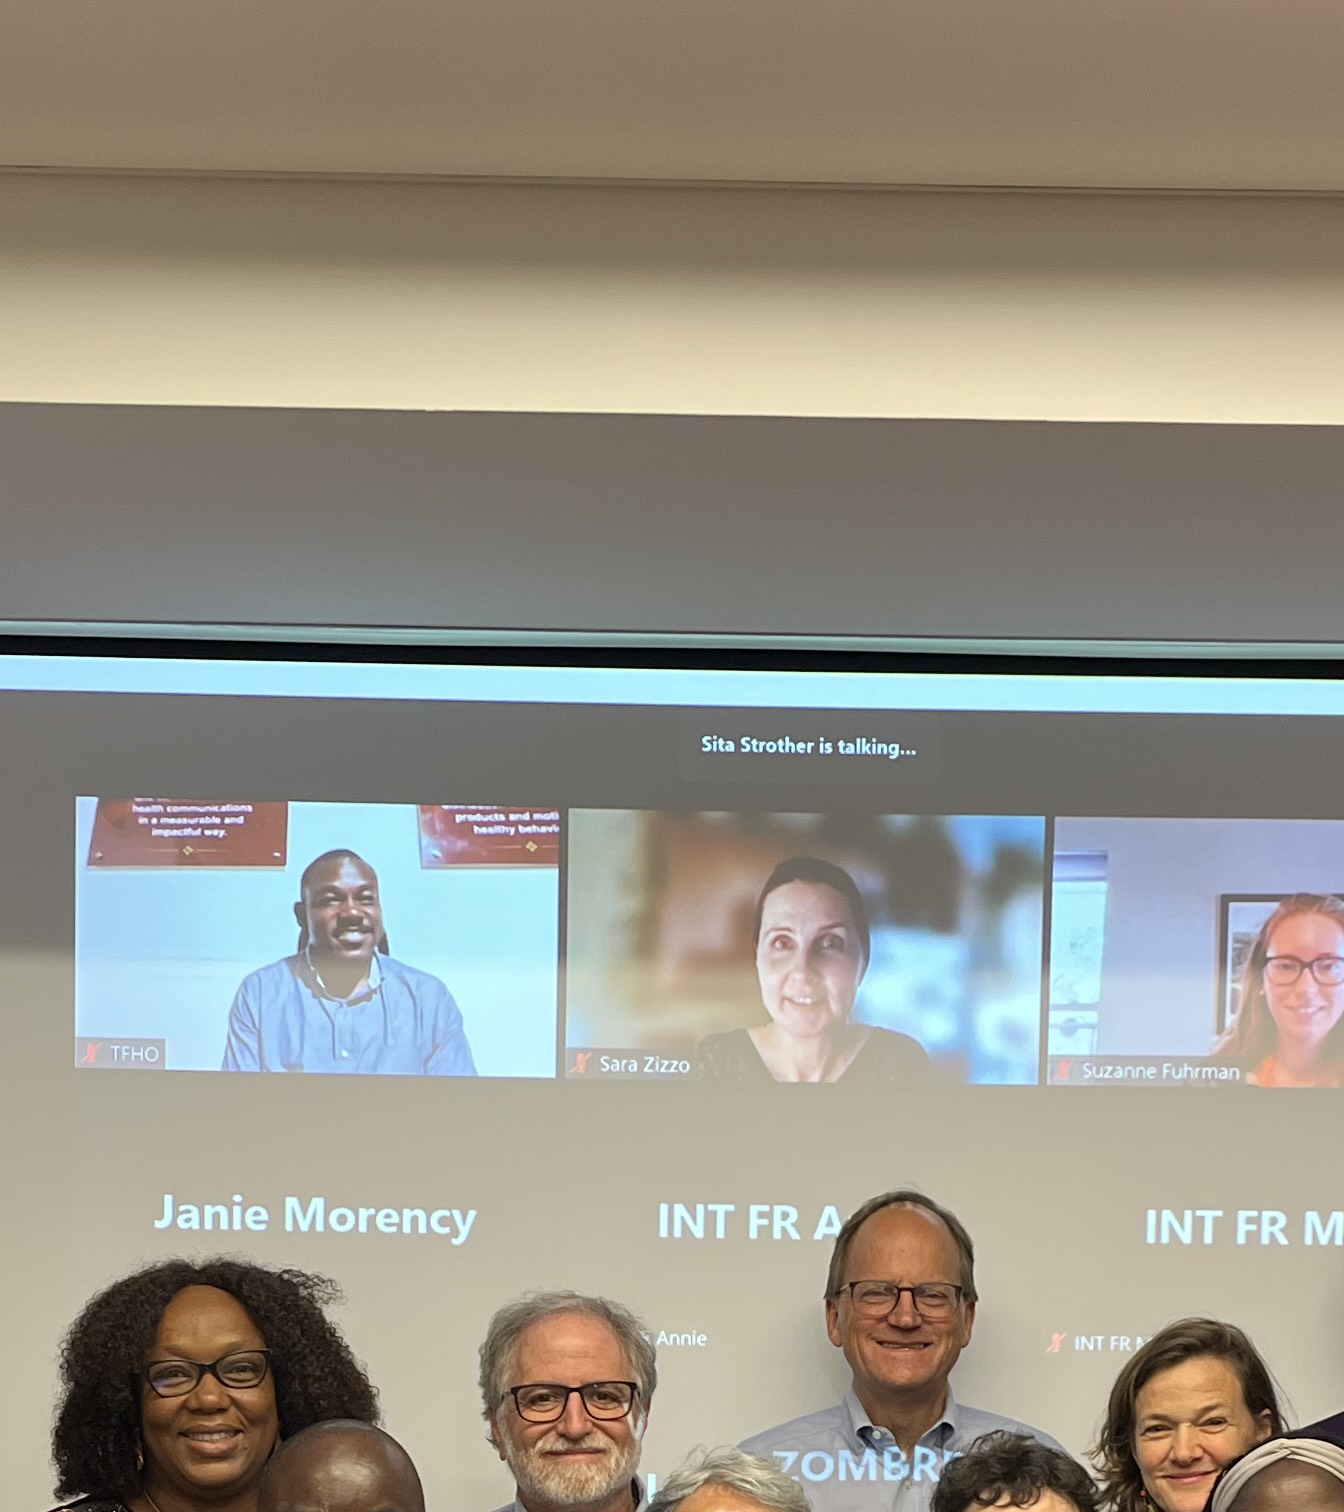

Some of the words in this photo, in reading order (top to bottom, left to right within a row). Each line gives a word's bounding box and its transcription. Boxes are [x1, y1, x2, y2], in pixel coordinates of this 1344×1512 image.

[701, 735, 735, 752] Sita
[740, 736, 814, 754] Strother
[819, 737, 833, 754] is
[838, 738, 916, 759] talking...
[110, 1045, 160, 1063] TFHO
[600, 1055, 638, 1072] Sara
[643, 1055, 690, 1073] Zizzo
[1082, 1062, 1156, 1079] Suzanne
[1163, 1063, 1240, 1081] Fuhrman
[154, 1194, 269, 1231] Janie
[284, 1196, 477, 1245] Morency
[659, 1203, 735, 1240] INT
[749, 1203, 801, 1240] FR
[1146, 1209, 1223, 1245] INT
[1236, 1209, 1289, 1245] FR
[656, 1329, 708, 1346] Annie
[1075, 1335, 1105, 1351] INT
[1110, 1335, 1131, 1351] FR
